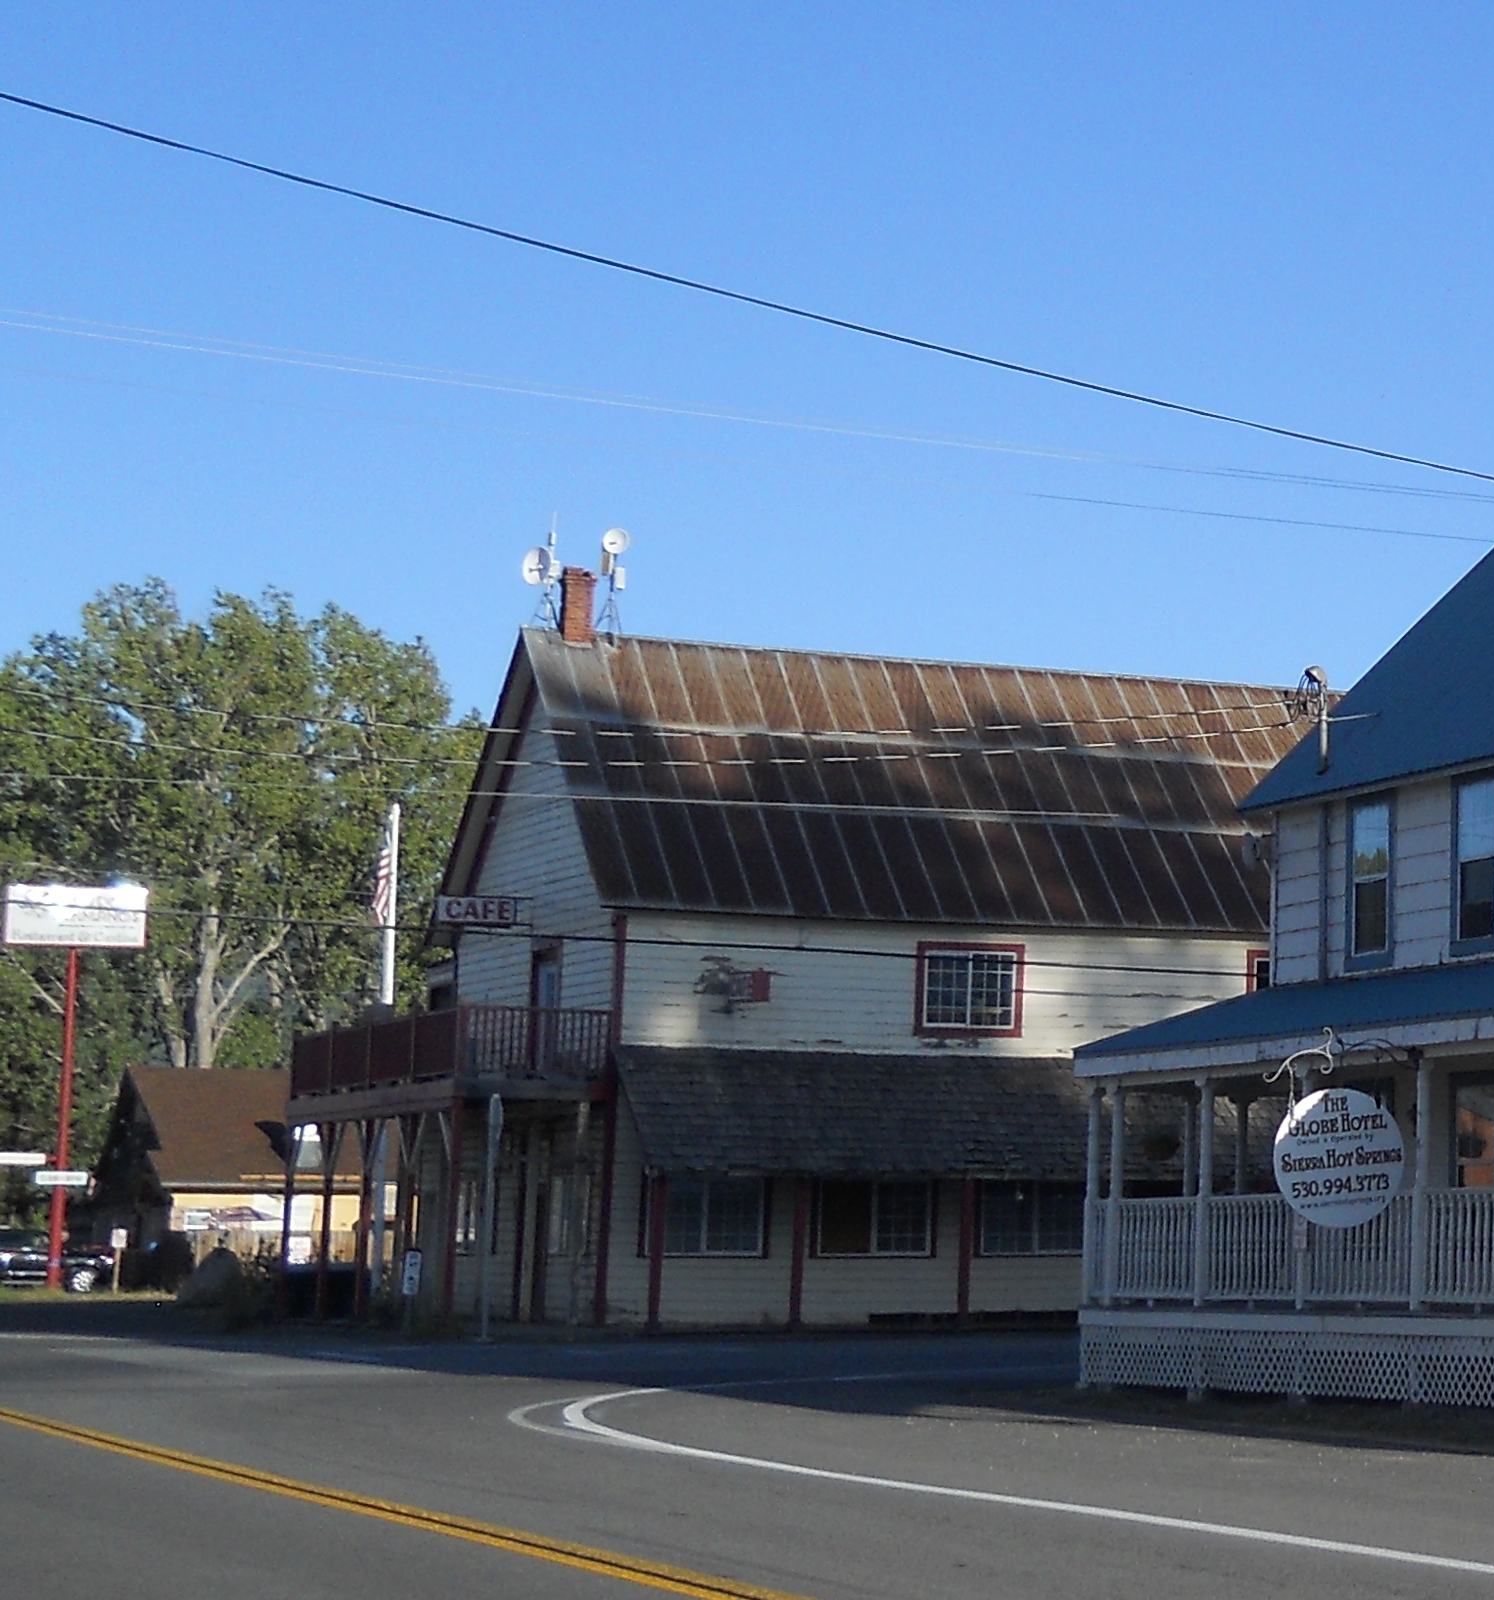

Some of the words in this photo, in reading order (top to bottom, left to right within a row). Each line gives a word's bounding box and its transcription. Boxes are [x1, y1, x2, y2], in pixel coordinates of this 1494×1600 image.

[445, 899, 511, 920] CAFE
[1323, 1093, 1349, 1114] THE
[1288, 1117, 1340, 1138] GLOBE
[1340, 1112, 1388, 1133] HOTEL
[1364, 1132, 1374, 1143] by
[1281, 1152, 1326, 1173] SIERRA
[1325, 1148, 1355, 1169] HOT
[1355, 1146, 1402, 1166] SPRINGS
[1291, 1172, 1390, 1199] 530.994.3773
